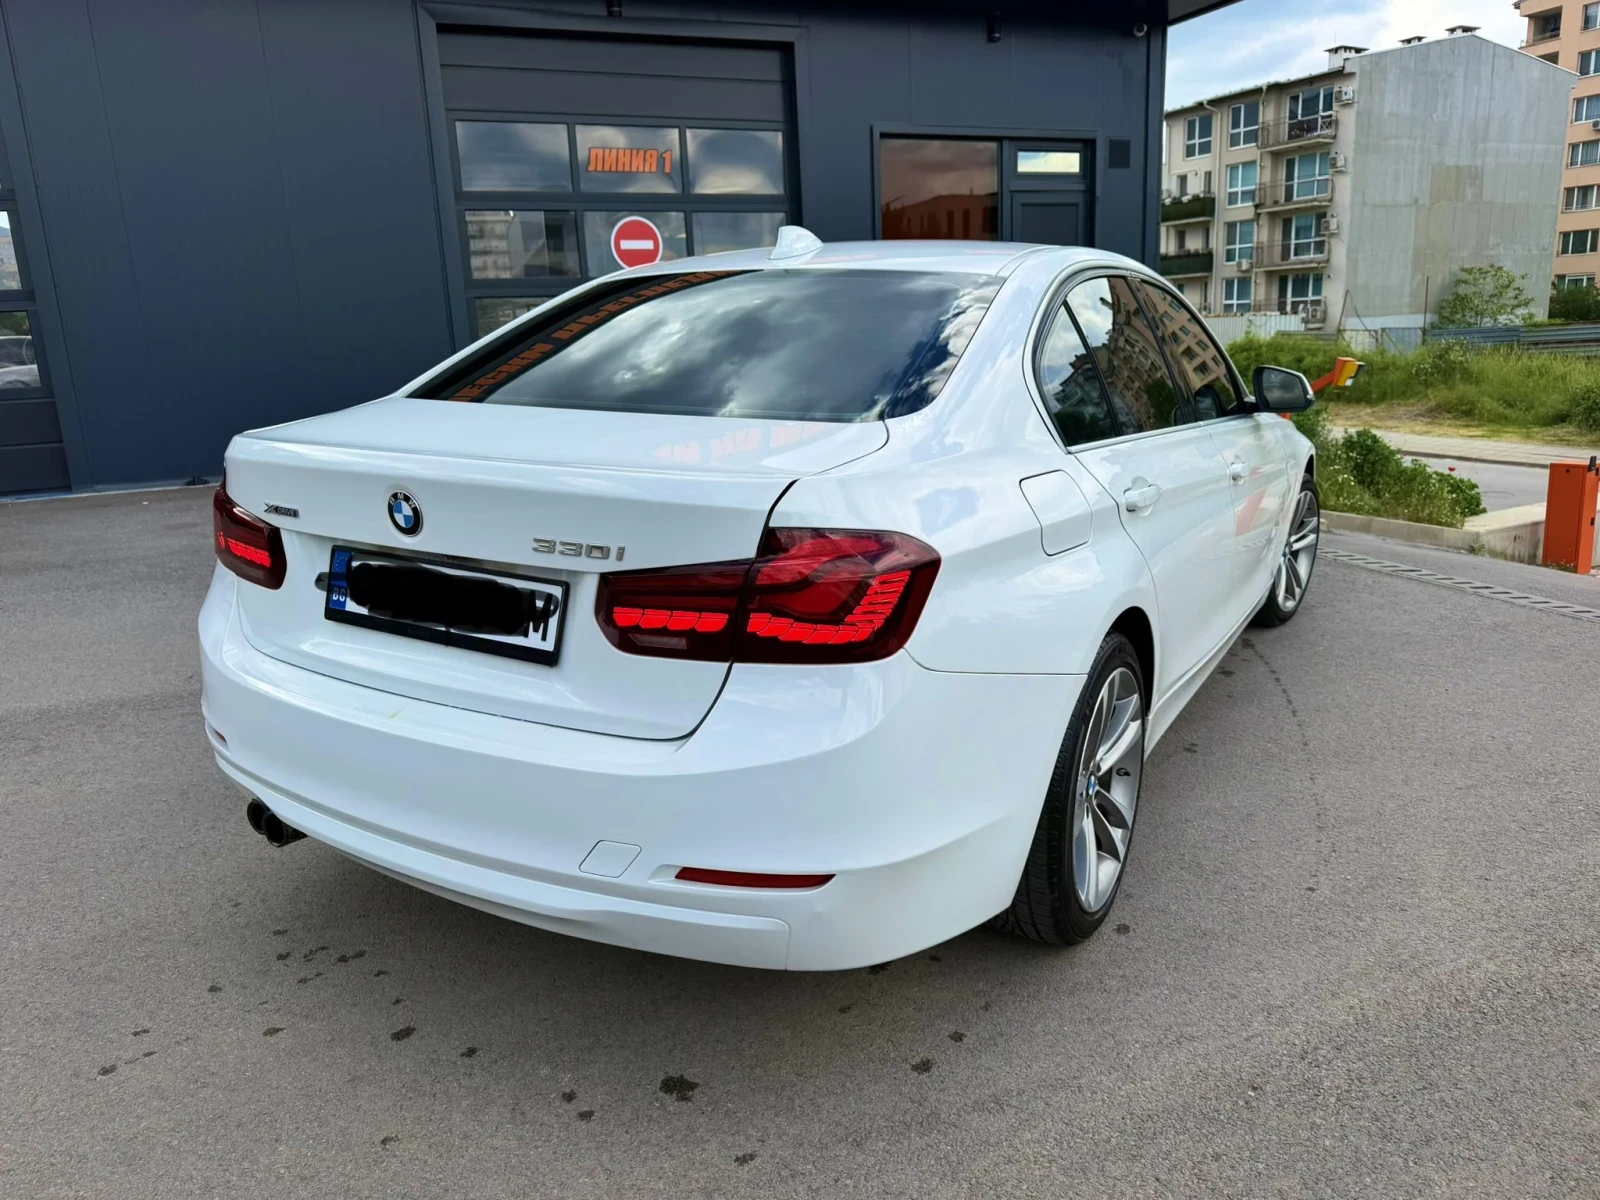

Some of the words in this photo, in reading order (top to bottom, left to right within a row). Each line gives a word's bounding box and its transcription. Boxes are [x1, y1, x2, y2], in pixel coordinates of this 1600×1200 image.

[588, 147, 658, 173] ЛИНИЯ
[661, 149, 672, 174] 1
[389, 491, 417, 509] BMW
[532, 537, 626, 562] 330i
